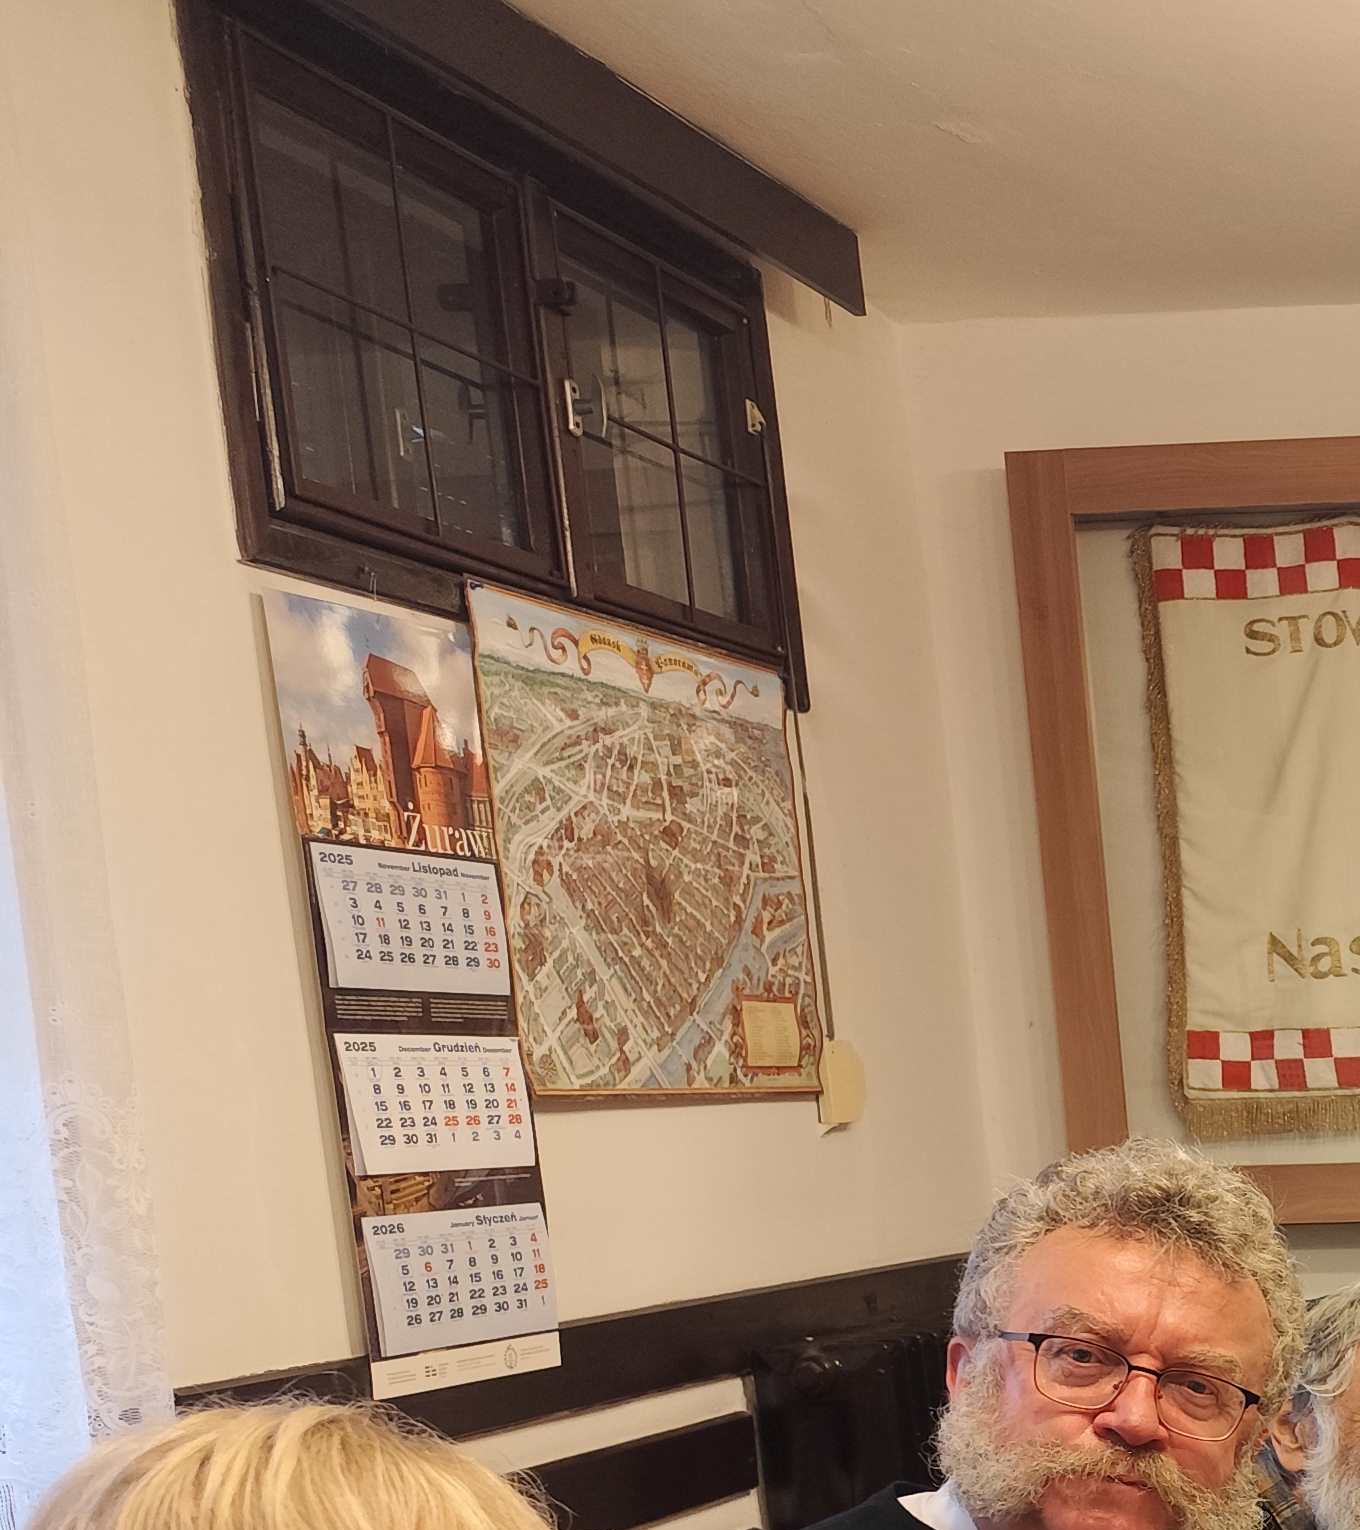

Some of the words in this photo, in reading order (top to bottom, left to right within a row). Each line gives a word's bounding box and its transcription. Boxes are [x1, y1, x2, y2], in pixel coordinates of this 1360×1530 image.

[319, 852, 353, 865] 2025
[412, 862, 458, 877] Listopad
[342, 880, 357, 891] 27
[367, 882, 383, 894] 28
[390, 885, 405, 896] 29
[412, 887, 427, 898] 30
[435, 889, 447, 900] 31
[462, 893, 465, 902] 1
[481, 894, 488, 904] 2
[350, 898, 358, 908] 3
[374, 900, 382, 910] 4
[397, 902, 404, 912] 5
[419, 904, 426, 914] 6
[441, 906, 447, 916] 7
[462, 908, 469, 918] 8
[484, 911, 491, 920] 9
[352, 916, 365, 926] 10
[376, 917, 385, 928] 11
[399, 919, 410, 929] 12
[420, 921, 431, 931] 13
[442, 923, 453, 933] 14
[464, 925, 474, 934] 15
[485, 927, 496, 936] 16
[355, 933, 367, 943] 17
[379, 934, 390, 945] 18
[400, 936, 412, 947] 19
[420, 938, 434, 948] 20
[443, 939, 455, 949] 21
[464, 941, 477, 951] 22
[484, 943, 498, 952] 23
[357, 950, 372, 960] 24
[379, 951, 394, 962] 25
[400, 952, 415, 963] 26
[423, 954, 436, 964] 27
[444, 956, 458, 966] 28
[466, 957, 480, 967] 29
[487, 959, 500, 968] 30
[344, 1042, 376, 1052] 2025
[433, 1042, 481, 1053] Grudzień
[371, 1068, 376, 1077] 1
[393, 1067, 401, 1077] 2
[417, 1067, 425, 1077] 3
[440, 1067, 447, 1077] 4
[461, 1067, 469, 1077] 5
[483, 1067, 490, 1077] 6
[503, 1067, 510, 1077] 7
[373, 1084, 381, 1094] 8
[397, 1084, 405, 1094] 9
[419, 1084, 431, 1093] 10
[442, 1084, 450, 1093] 11
[463, 1084, 475, 1093] 12
[484, 1083, 495, 1093] 13
[505, 1083, 516, 1092] 14
[375, 1101, 388, 1111] 15
[399, 1101, 411, 1111] 16
[422, 1100, 433, 1110] 17
[444, 1100, 456, 1110] 18
[466, 1099, 477, 1109] 19
[485, 1099, 499, 1109] 20
[507, 1099, 517, 1108] 21
[376, 1118, 393, 1129] 22
[400, 1117, 416, 1127] 23
[423, 1117, 437, 1127] 24
[444, 1116, 459, 1126] 25
[466, 1116, 480, 1126] 26
[487, 1115, 501, 1125] 27
[508, 1114, 522, 1124] 28
[379, 1135, 396, 1146] 29
[403, 1134, 418, 1144] 30
[426, 1133, 438, 1143] 31
[451, 1133, 455, 1142] 1
[472, 1132, 480, 1141] 2
[493, 1131, 501, 1141] 3
[514, 1130, 521, 1140] 4
[475, 1212, 517, 1226] Styczeń
[372, 1223, 405, 1235] 2026
[394, 1248, 410, 1259] 29
[418, 1246, 433, 1256] 30
[441, 1243, 454, 1254] 31
[468, 1241, 472, 1250] 1
[489, 1239, 496, 1248] 2
[510, 1236, 517, 1246] 3
[530, 1233, 537, 1242] 4
[402, 1265, 409, 1275] 5
[425, 1262, 432, 1272] 6
[446, 1259, 453, 1269] 7
[469, 1257, 477, 1267] 8
[491, 1254, 498, 1264] 9
[511, 1252, 522, 1262] 10
[533, 1248, 540, 1258] 11
[403, 1281, 416, 1292] 12
[426, 1278, 438, 1288] 13
[448, 1276, 459, 1286] 14
[469, 1273, 482, 1283] 15
[492, 1270, 503, 1280] 16
[513, 1267, 524, 1277] 17
[534, 1264, 545, 1273] 18
[406, 1298, 418, 1309] 19
[427, 1295, 441, 1306] 20
[449, 1292, 459, 1303] 21
[469, 1288, 485, 1299] 22
[492, 1286, 507, 1296] 23
[514, 1282, 528, 1293] 24
[534, 1279, 548, 1290] 25
[407, 1315, 422, 1326] 26
[429, 1311, 443, 1322] 27
[450, 1308, 464, 1319] 28
[472, 1304, 487, 1315] 29
[494, 1301, 509, 1312] 30
[517, 1299, 527, 1309] 31
[541, 1296, 545, 1305] 1
